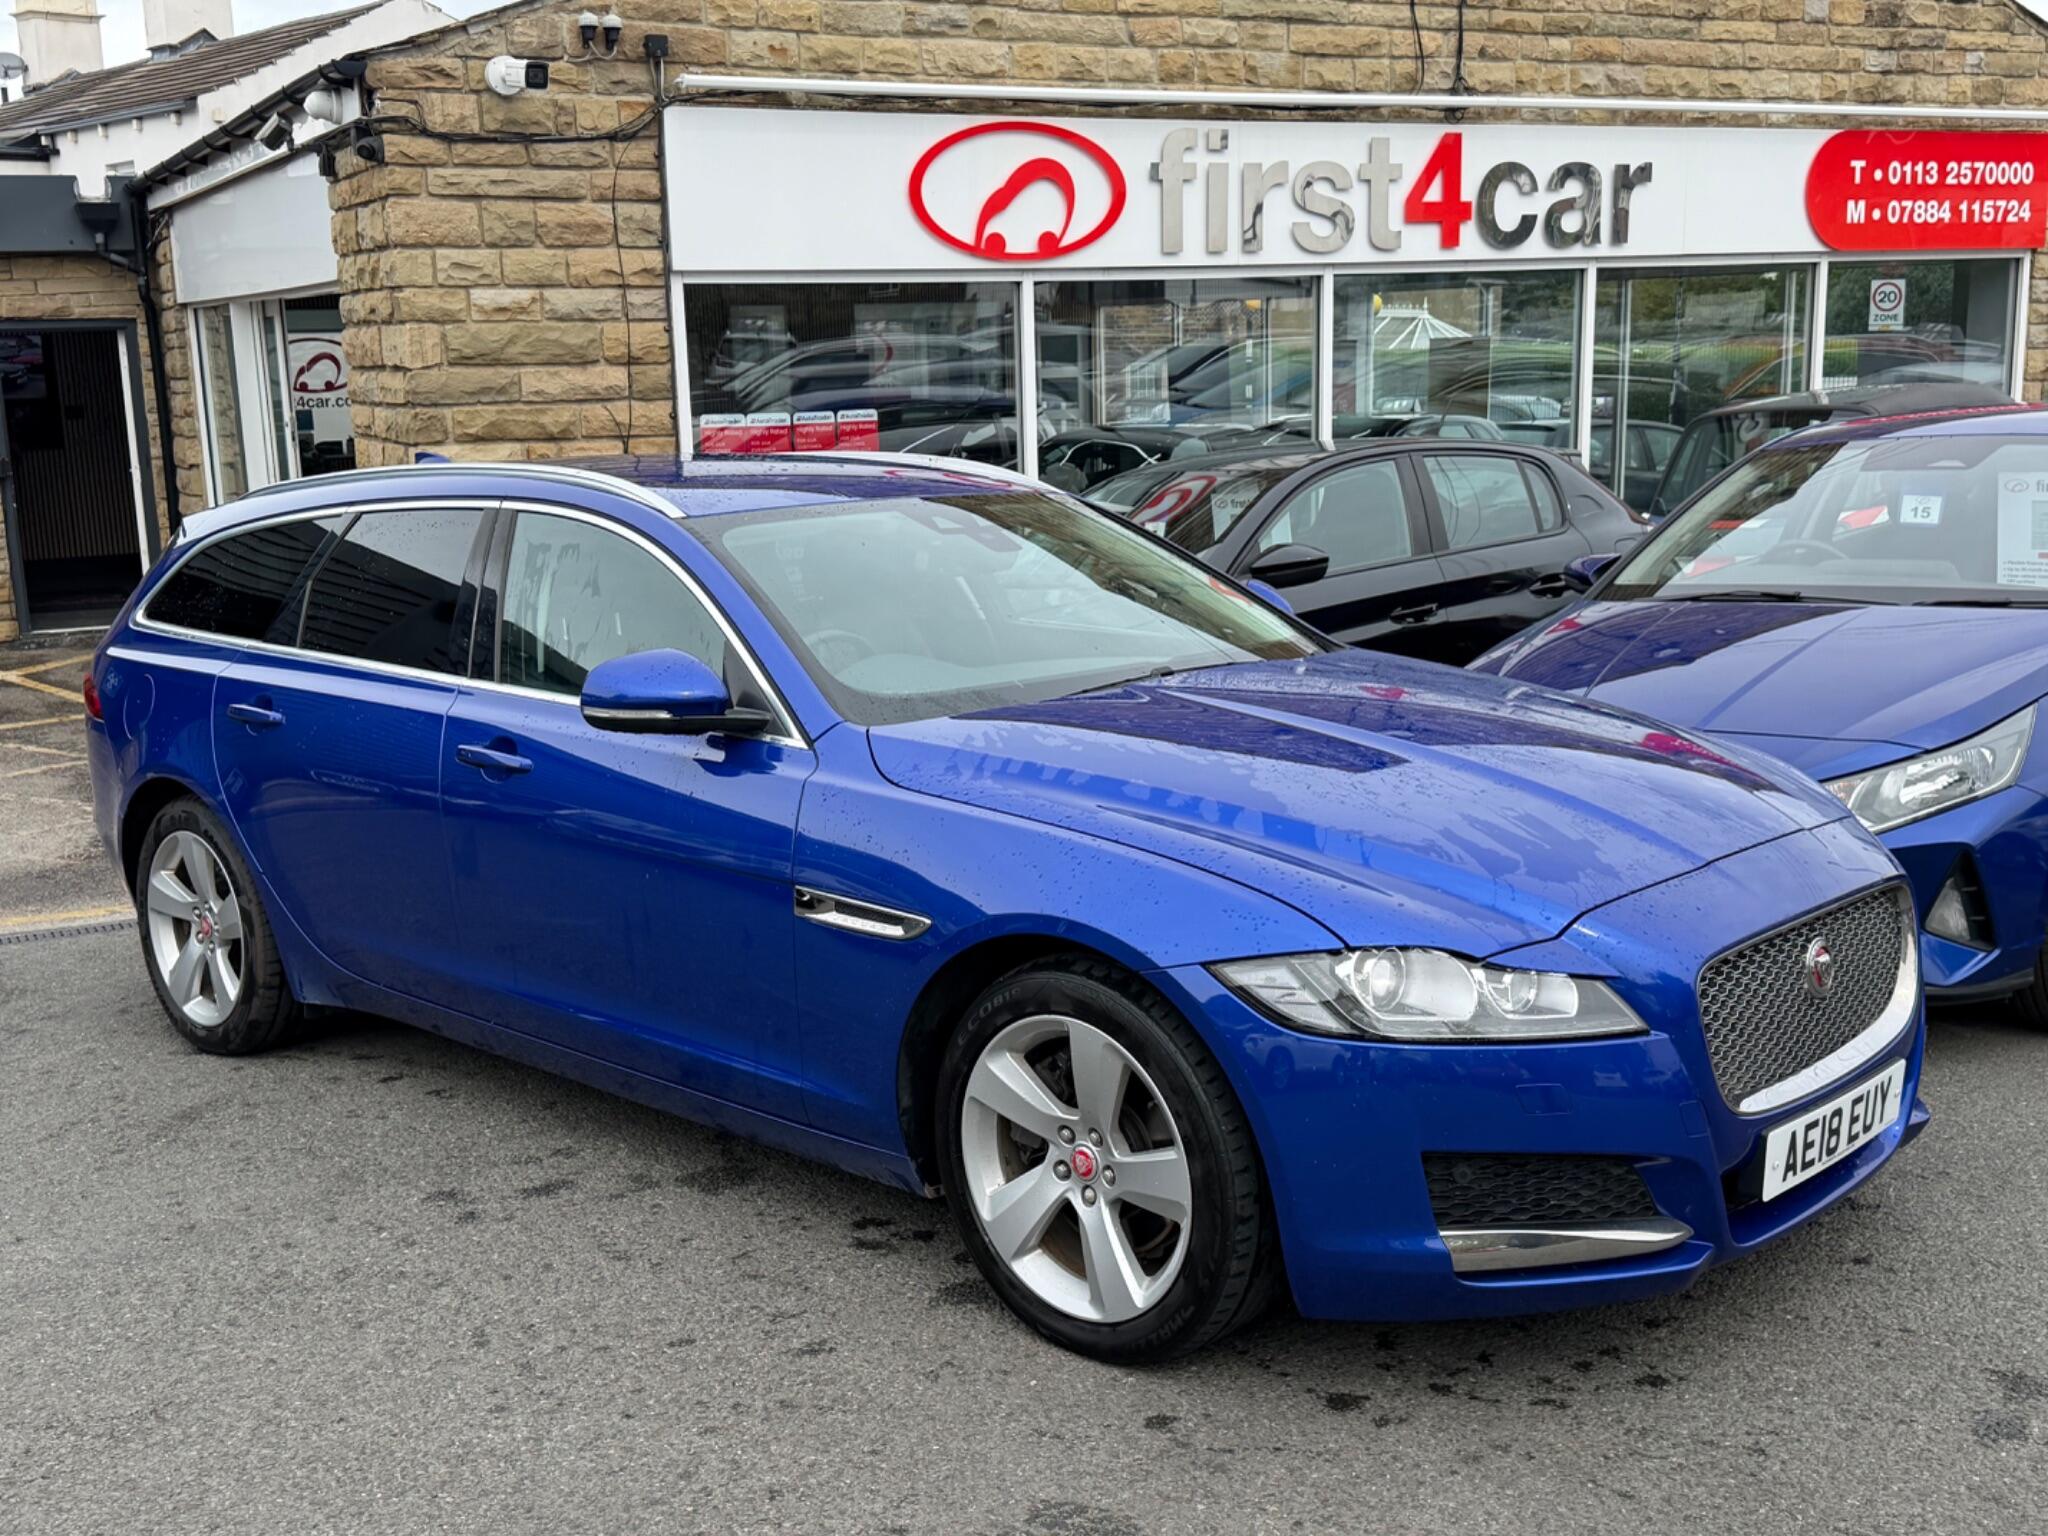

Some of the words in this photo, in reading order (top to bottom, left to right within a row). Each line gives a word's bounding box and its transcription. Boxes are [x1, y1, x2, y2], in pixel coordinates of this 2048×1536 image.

[1850, 159, 1866, 184] T
[1887, 160, 1938, 185] 0113
[1945, 161, 2035, 185] 2570000
[1149, 126, 1653, 254] first4car
[1846, 199, 1865, 224] M
[1886, 199, 1951, 223] 07884
[1958, 199, 2031, 223] 115724
[1878, 290, 1897, 304] 20
[1872, 313, 1898, 322] ZONE
[1910, 506, 1931, 519] 15
[1782, 1106, 1844, 1183] AE18
[1847, 1074, 1893, 1145] EUY
